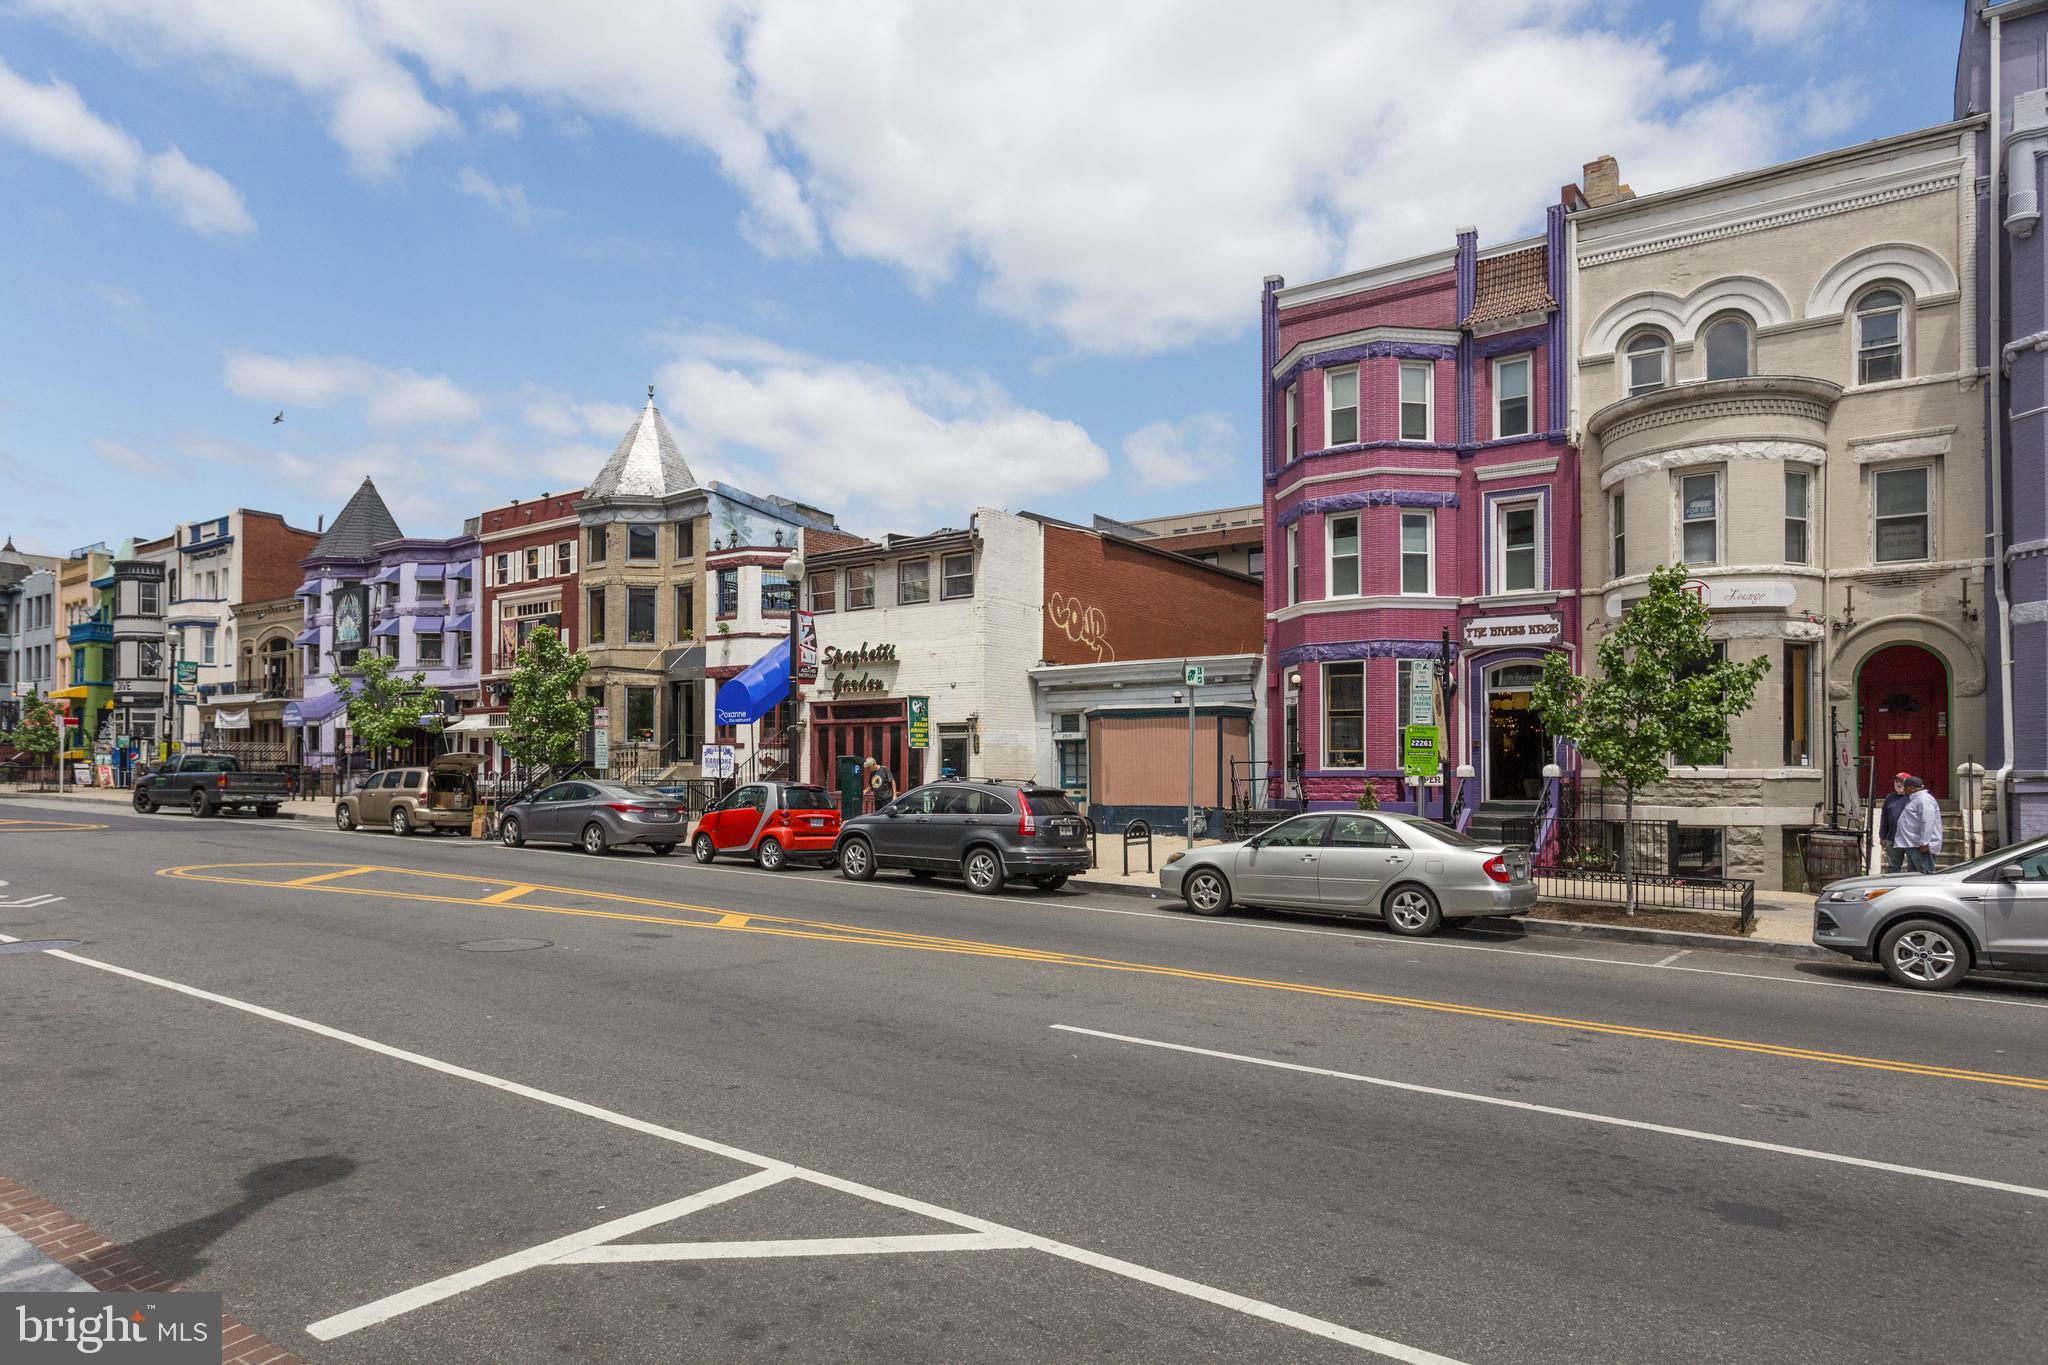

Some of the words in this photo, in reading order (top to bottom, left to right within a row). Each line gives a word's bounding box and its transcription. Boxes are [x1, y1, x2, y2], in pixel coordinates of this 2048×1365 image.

[1724, 588, 1767, 605] Lounge
[1465, 627, 1487, 639] THE
[1489, 625, 1526, 637] BRASS
[1528, 623, 1559, 635] KNOB
[800, 615, 817, 666] EAT
[821, 641, 896, 671] Spaghetti
[832, 671, 885, 701] Garden
[715, 708, 747, 724] Roxanne
[1411, 739, 1433, 747] 22261
[704, 757, 732, 765] KAROKE
[854, 765, 860, 774] P
